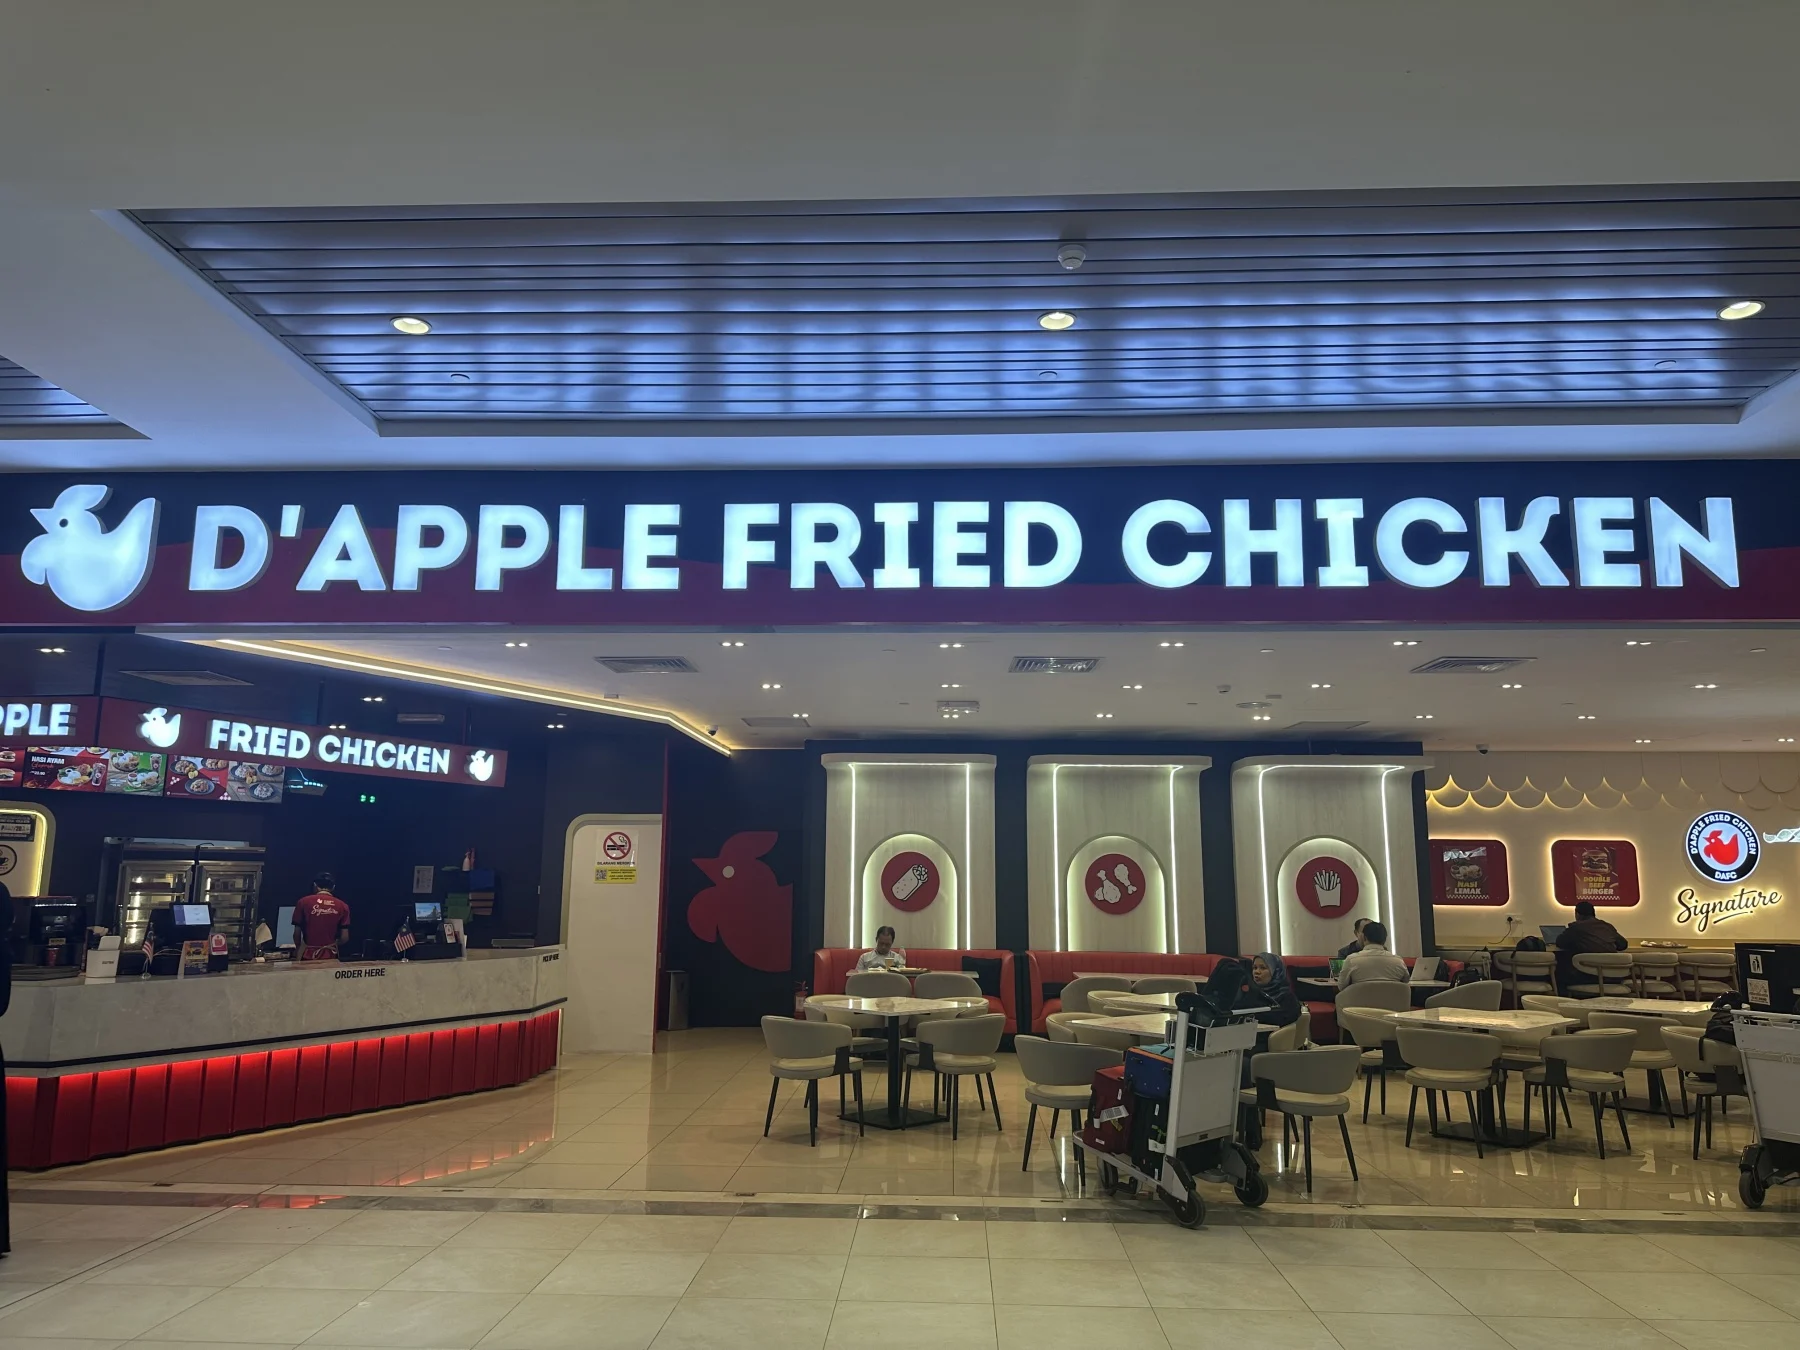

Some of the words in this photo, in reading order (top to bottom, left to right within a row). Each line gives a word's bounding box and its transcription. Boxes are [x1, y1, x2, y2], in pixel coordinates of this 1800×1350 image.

[188, 503, 682, 591] D'APPLE
[722, 501, 1083, 590] FRIED
[1121, 496, 1741, 589] CHICKEN
[0, 703, 72, 736] PLE
[209, 719, 311, 759] FRIED
[318, 734, 451, 775] CHICKEN
[1689, 820, 1706, 855] D'APPLE
[1704, 814, 1731, 824] FRIED
[1732, 818, 1757, 855] CHICKEN
[1454, 887, 1481, 895] LEMAK
[1714, 871, 1738, 880] DAFC
[1676, 888, 1783, 932] Signature
[334, 969, 363, 980] ORDER
[364, 968, 386, 978] HERE
